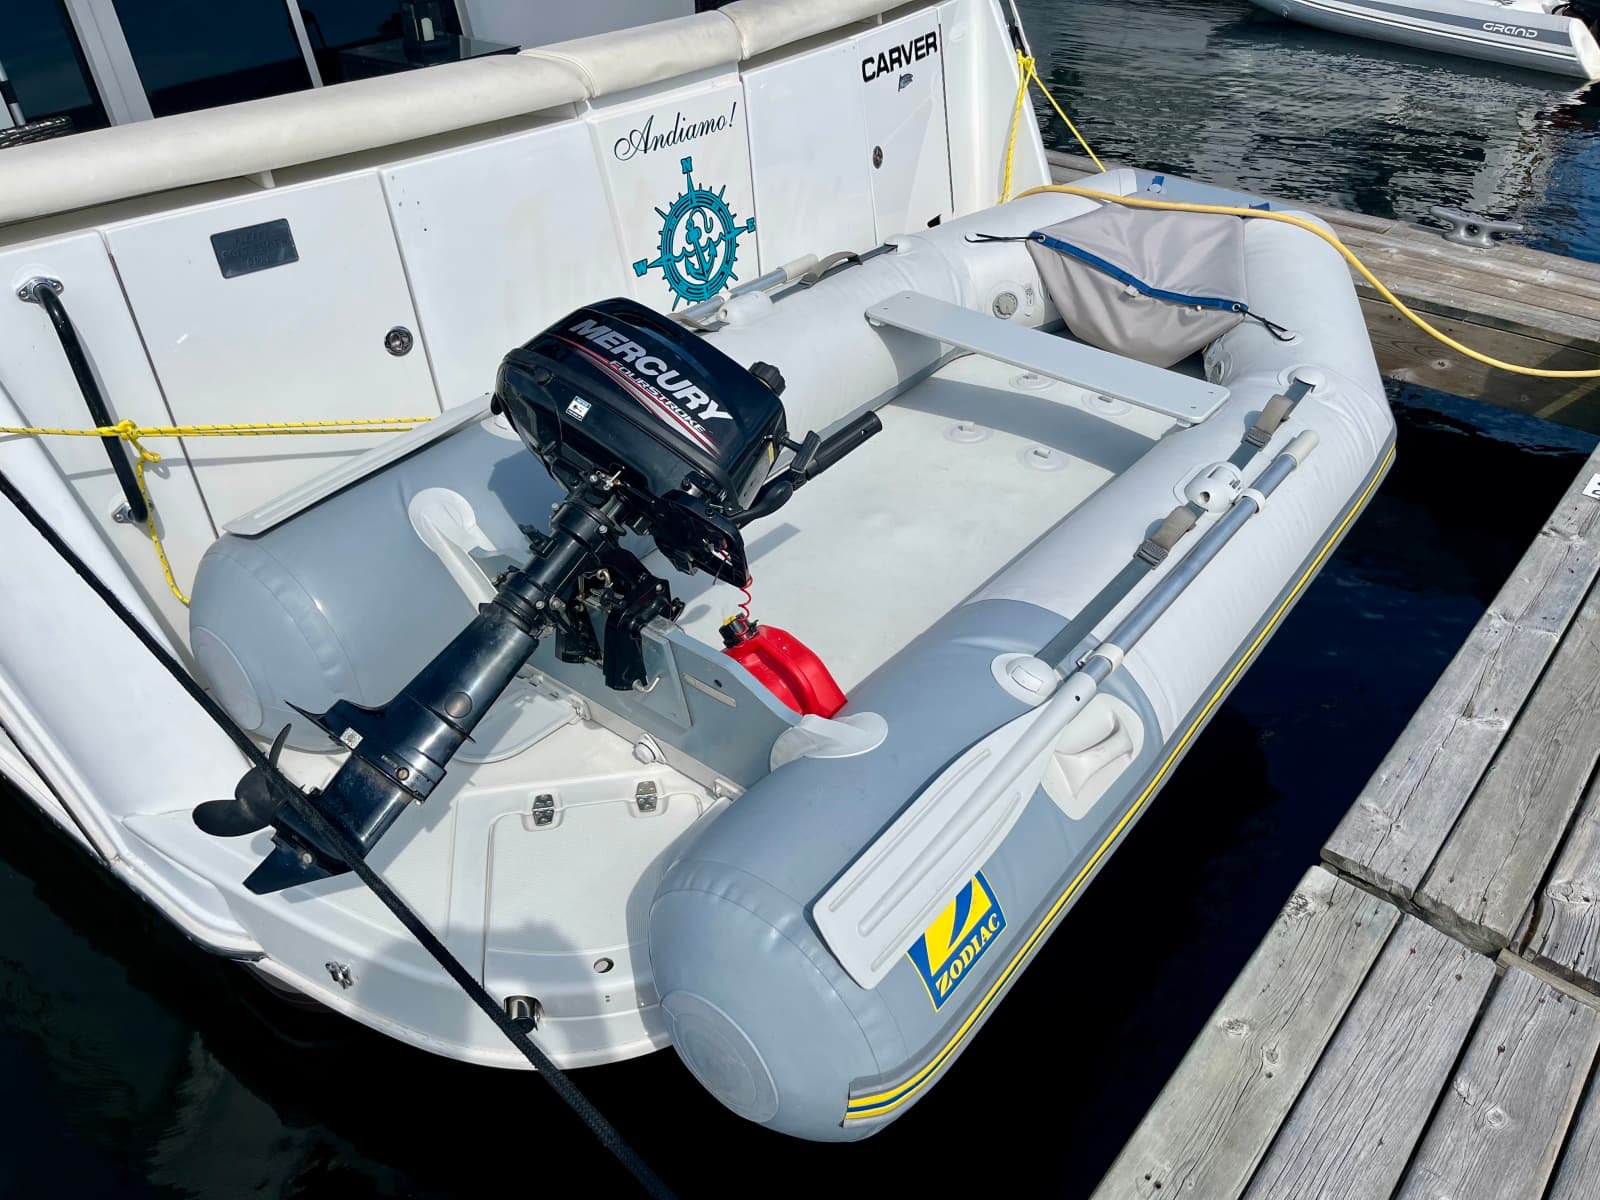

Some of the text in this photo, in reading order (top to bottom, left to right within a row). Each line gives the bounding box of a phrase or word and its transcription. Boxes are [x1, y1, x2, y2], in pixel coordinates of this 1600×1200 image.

[861, 31, 938, 83] CARVER
[1482, 22, 1539, 38] GRAND
[614, 101, 737, 161] Andiamo!
[680, 156, 694, 175] N
[632, 258, 649, 277] W
[568, 319, 734, 421] MERCURY
[609, 360, 707, 434] FOURSTROKE
[935, 912, 1000, 998] ZODIAC
